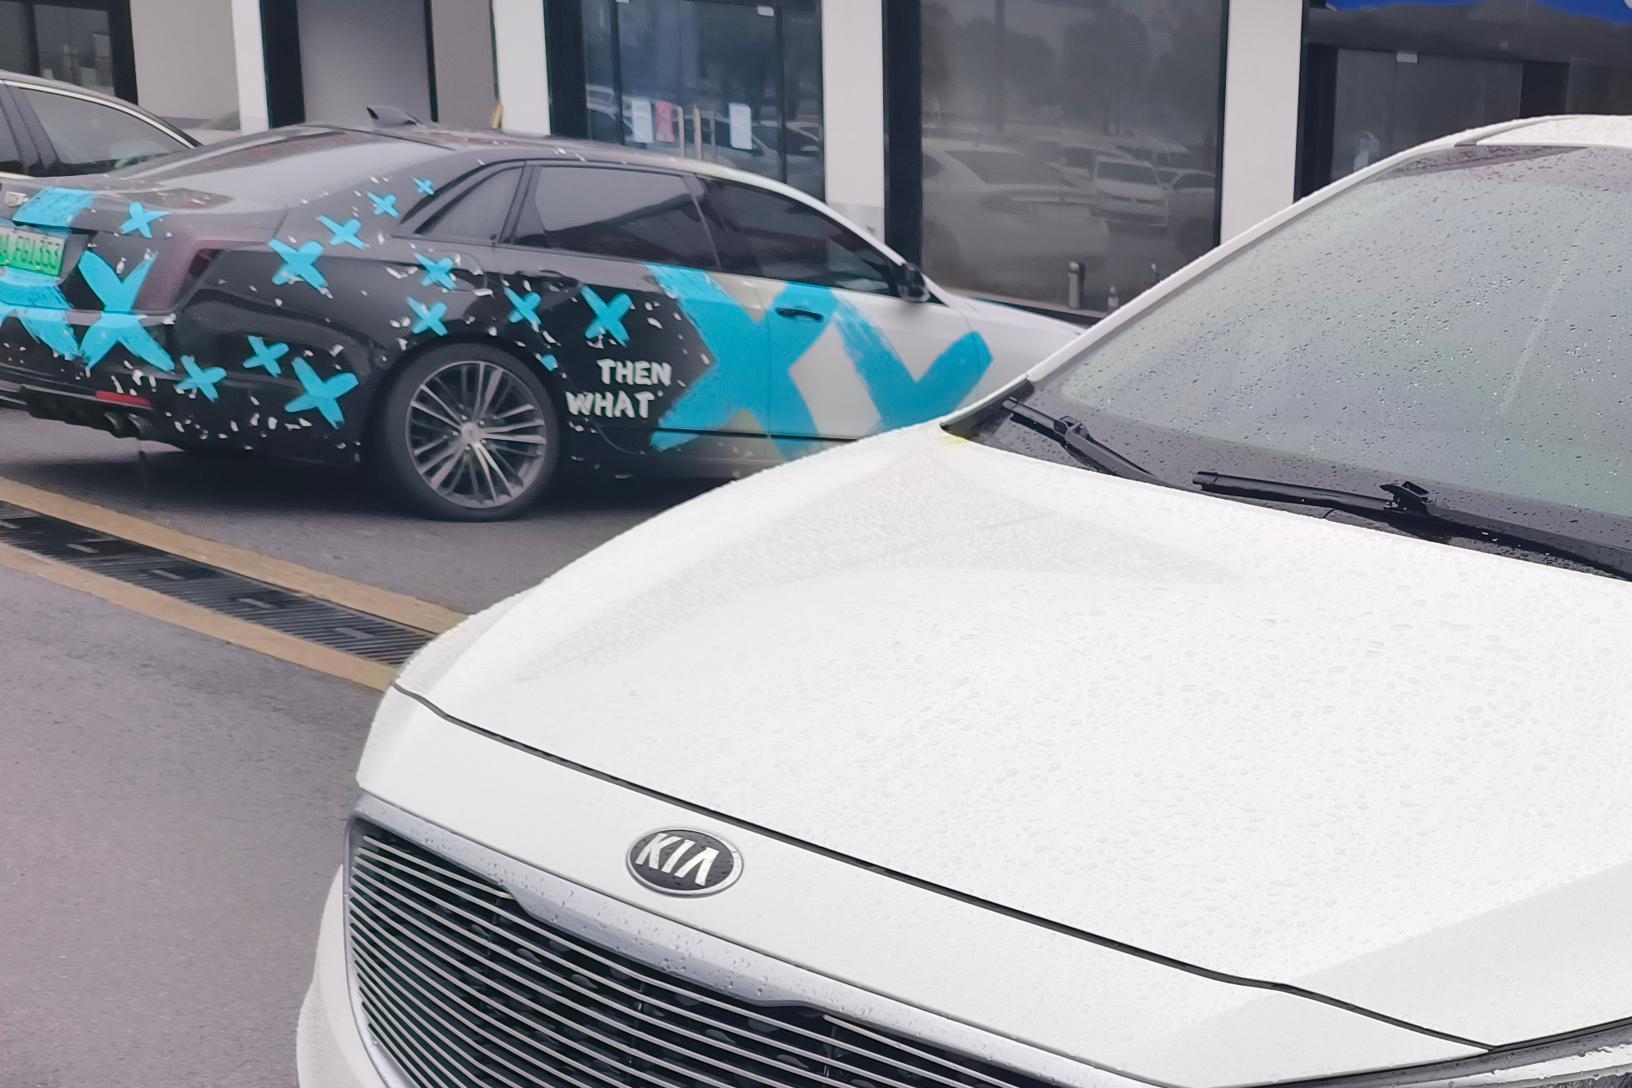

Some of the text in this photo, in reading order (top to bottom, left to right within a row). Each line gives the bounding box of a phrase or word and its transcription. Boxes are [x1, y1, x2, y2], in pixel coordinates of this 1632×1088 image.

[597, 359, 672, 387] THEN
[564, 391, 656, 418] WHAT
[634, 832, 721, 887] KIA
